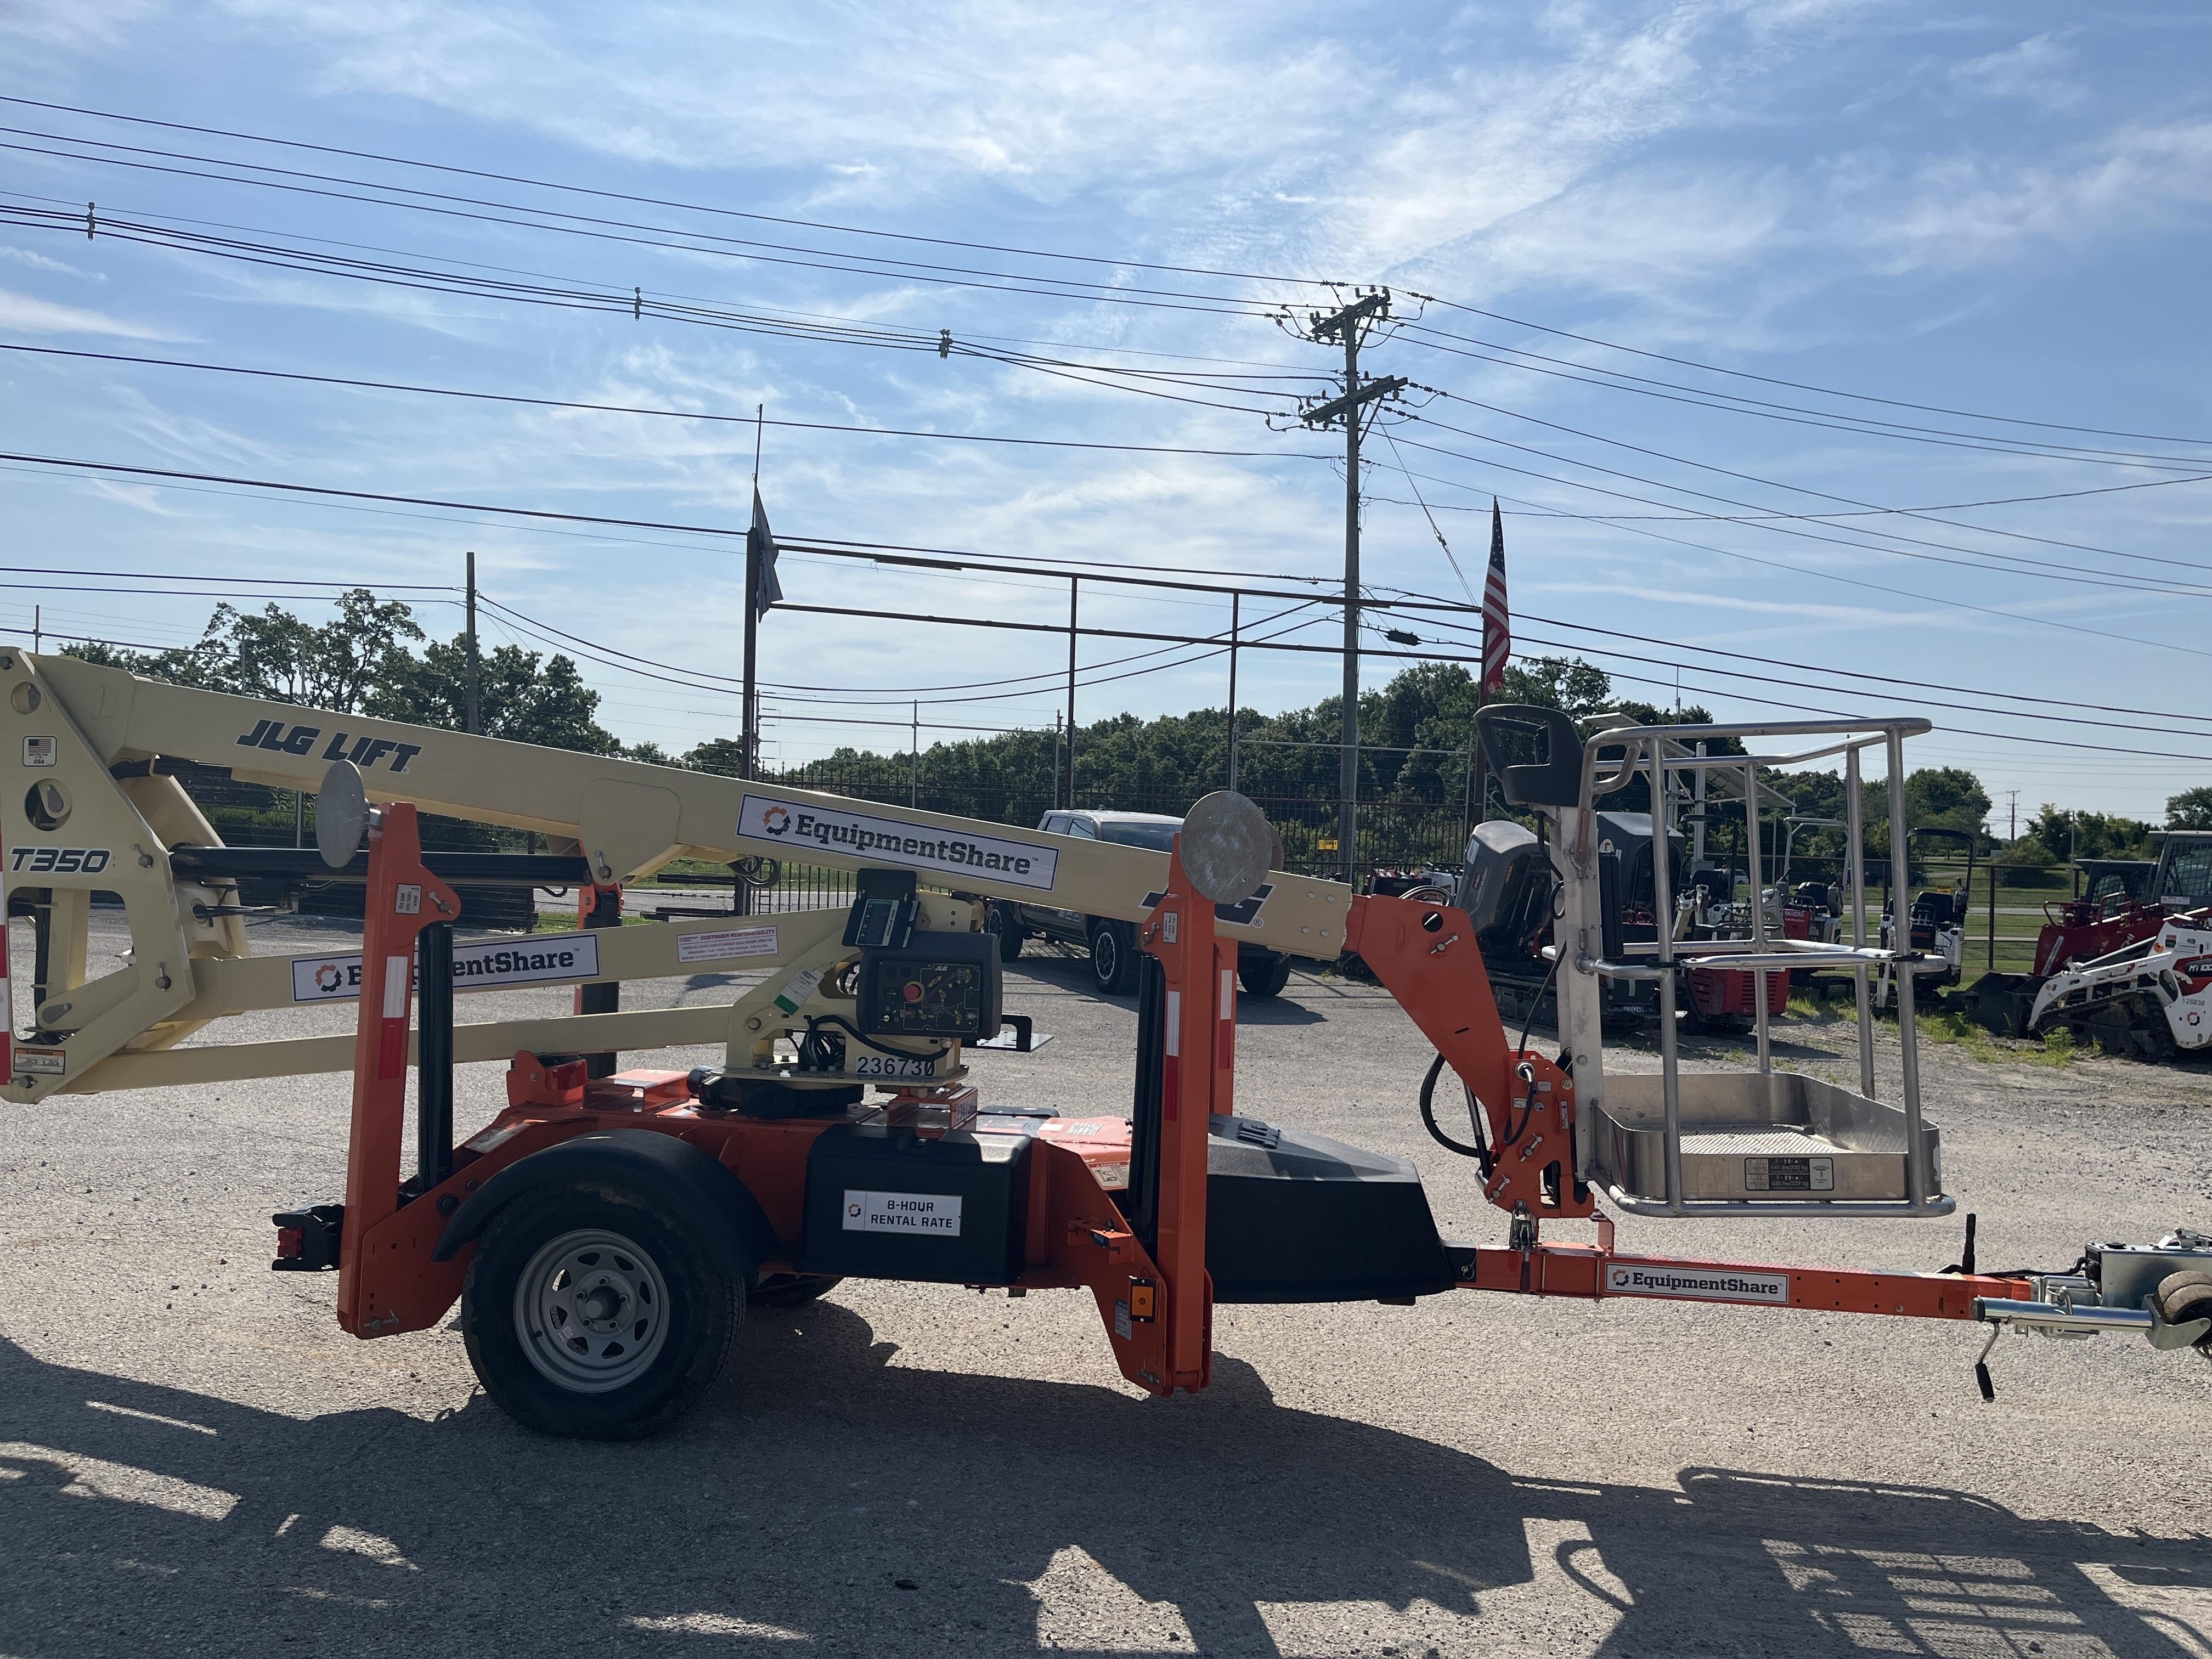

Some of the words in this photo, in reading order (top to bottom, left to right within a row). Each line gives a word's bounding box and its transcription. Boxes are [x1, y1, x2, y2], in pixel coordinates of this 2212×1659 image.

[236, 719, 322, 756] JLG
[321, 732, 422, 772] LIFT
[795, 814, 1030, 874] EquipmentShare
[12, 848, 110, 873] T350
[347, 950, 574, 986] EentShare
[856, 1057, 935, 1076] 236730
[887, 1200, 934, 1212] 8-HOUR
[871, 1214, 917, 1226] RENTAL
[922, 1217, 952, 1228] RATE
[1632, 1272, 1778, 1294] EquipmentShare
